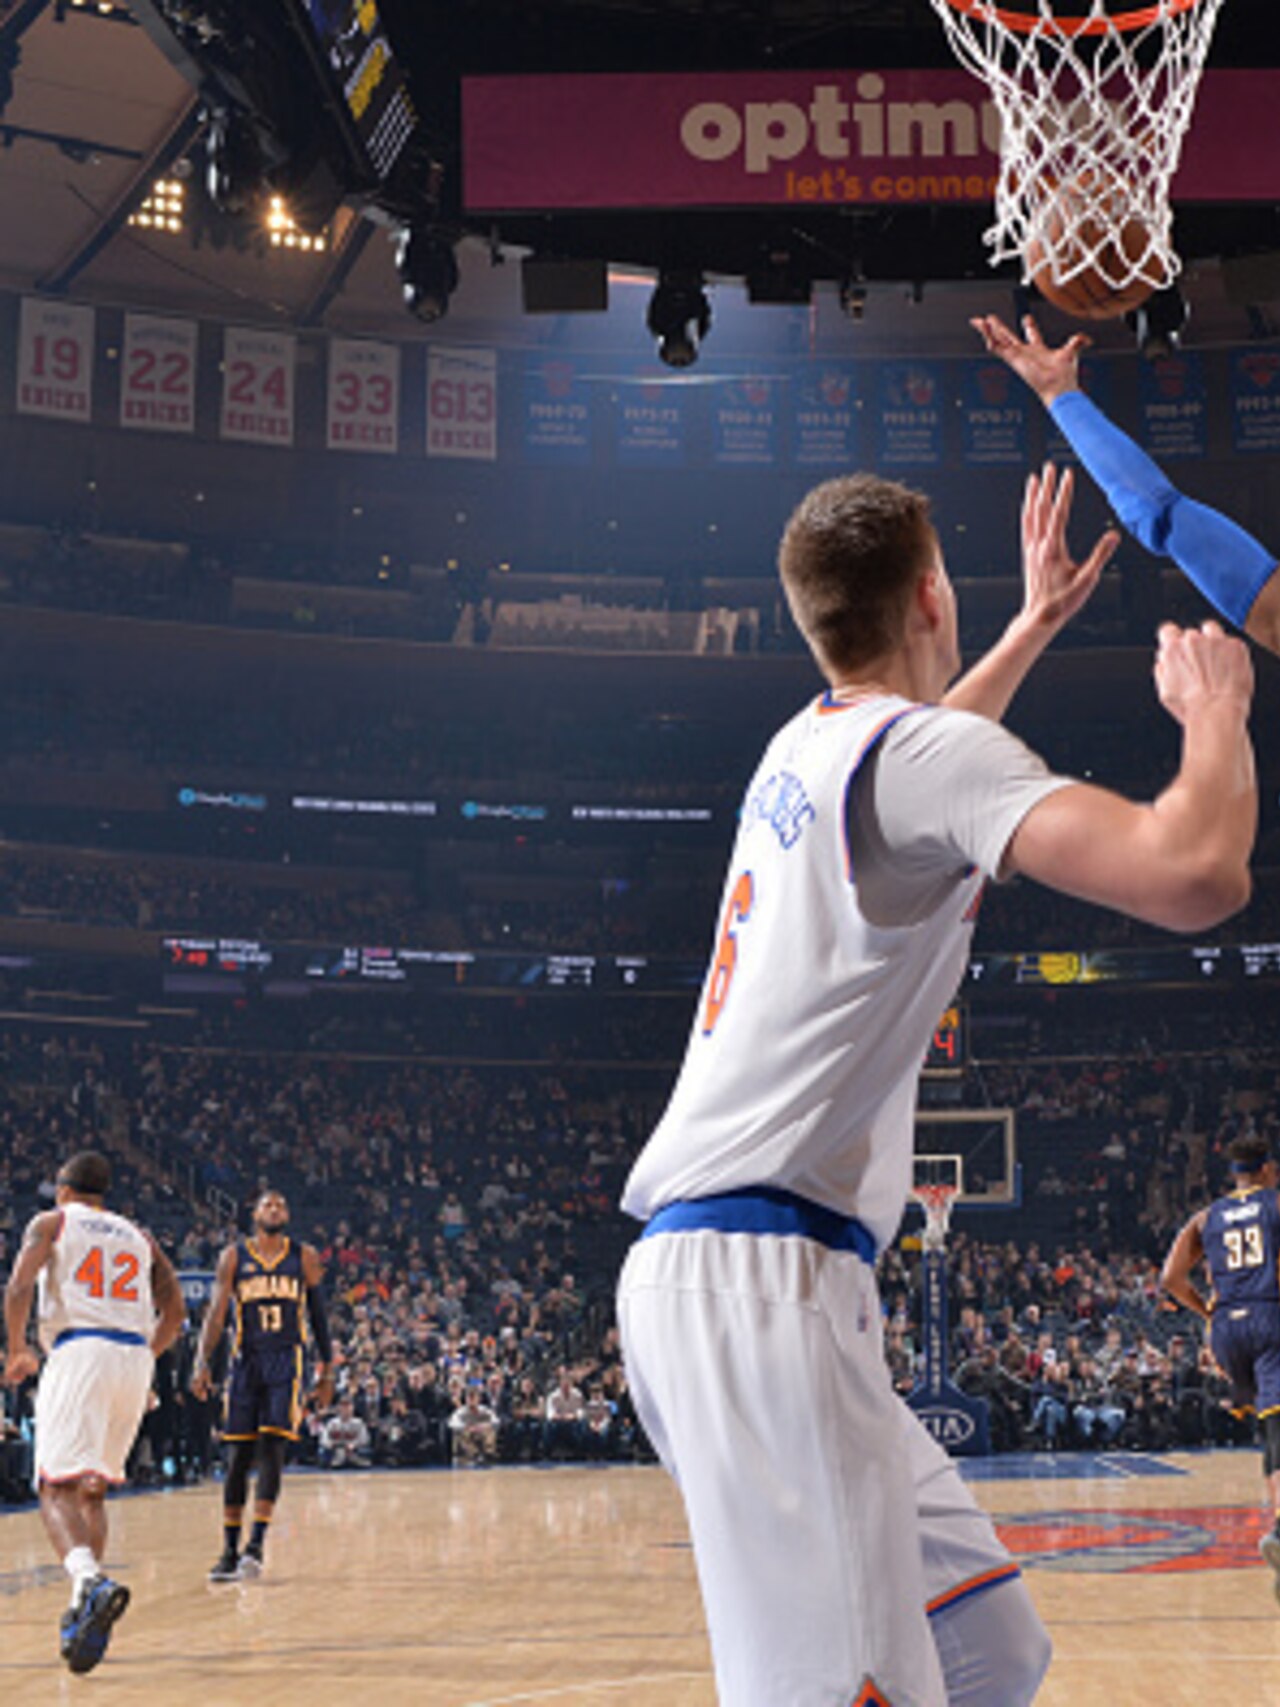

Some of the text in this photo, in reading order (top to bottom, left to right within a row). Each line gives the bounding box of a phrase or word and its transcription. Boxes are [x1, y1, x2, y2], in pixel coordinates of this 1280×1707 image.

[786, 171, 863, 200] let's
[32, 335, 80, 382] 19
[128, 348, 191, 395] 22
[228, 360, 287, 410] 24
[335, 373, 393, 415] 33
[430, 379, 494, 423] 613
[124, 400, 190, 423] KNICKS
[701, 868, 754, 1037] 6
[1223, 1224, 1264, 1271] 33
[74, 1246, 139, 1302] 42
[257, 1304, 283, 1333] 13
